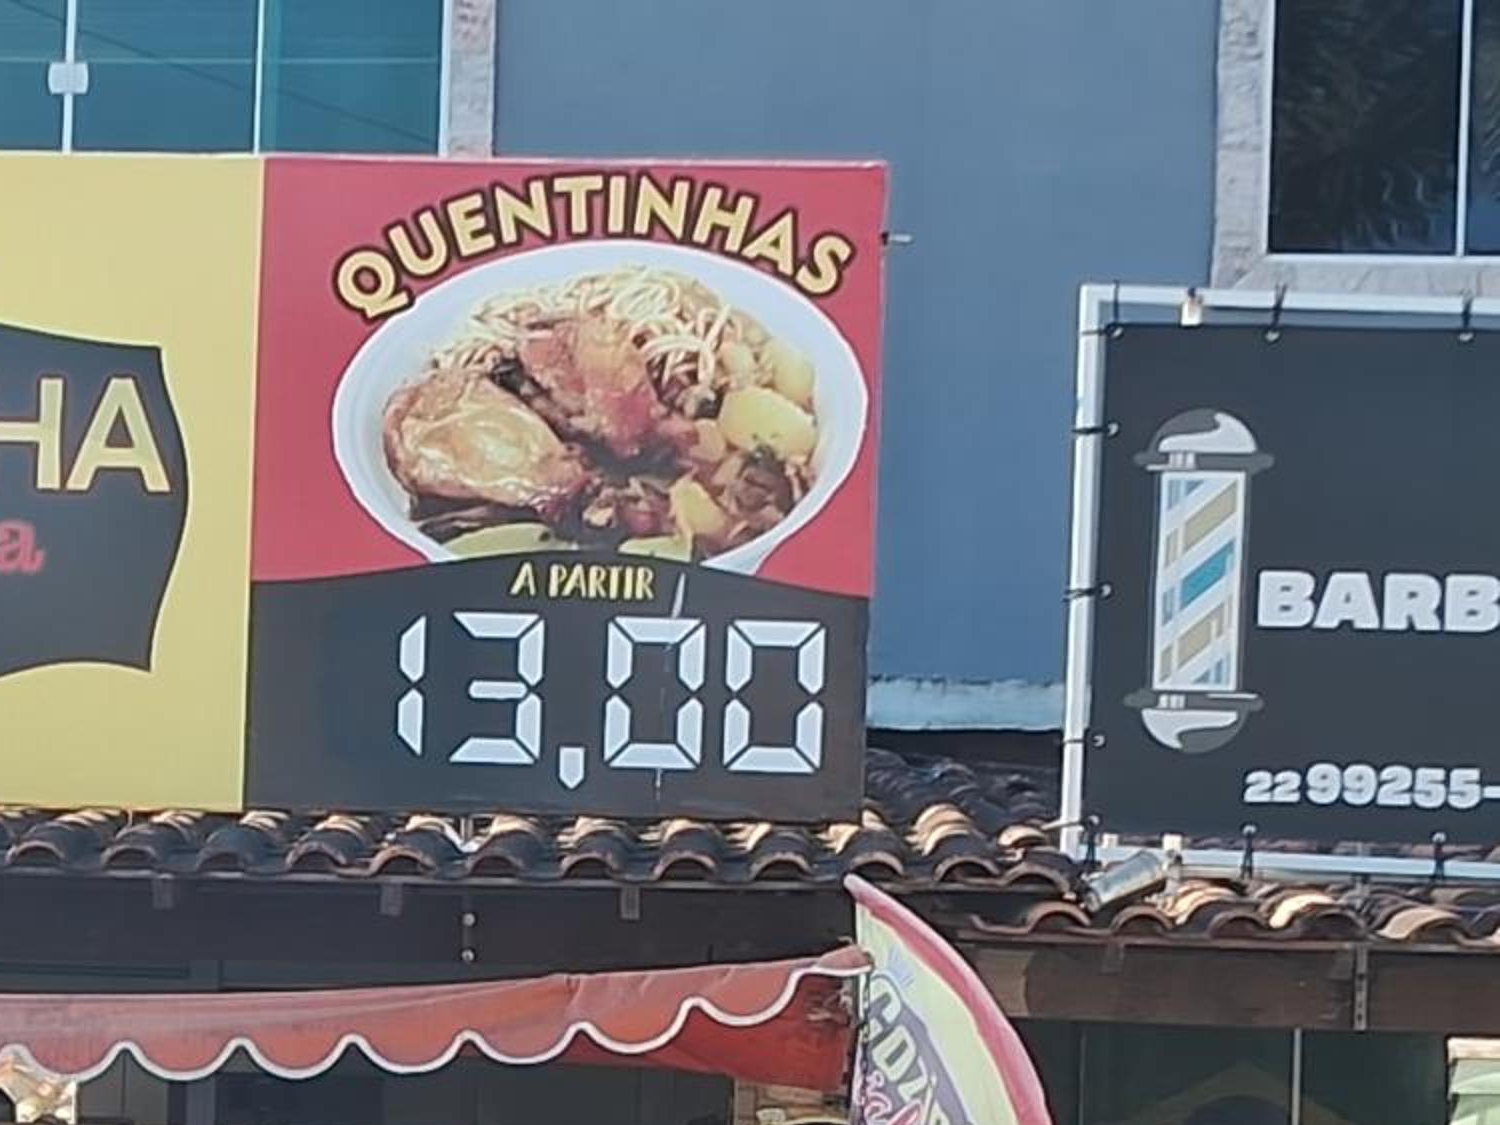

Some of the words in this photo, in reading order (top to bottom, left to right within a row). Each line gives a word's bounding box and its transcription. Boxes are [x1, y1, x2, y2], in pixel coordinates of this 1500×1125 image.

[336, 174, 855, 319] QUENTINHAS
[510, 562, 537, 596] A
[549, 563, 655, 600] PARTIR
[397, 612, 826, 789] 13,00
[1243, 770, 1301, 803] 22
